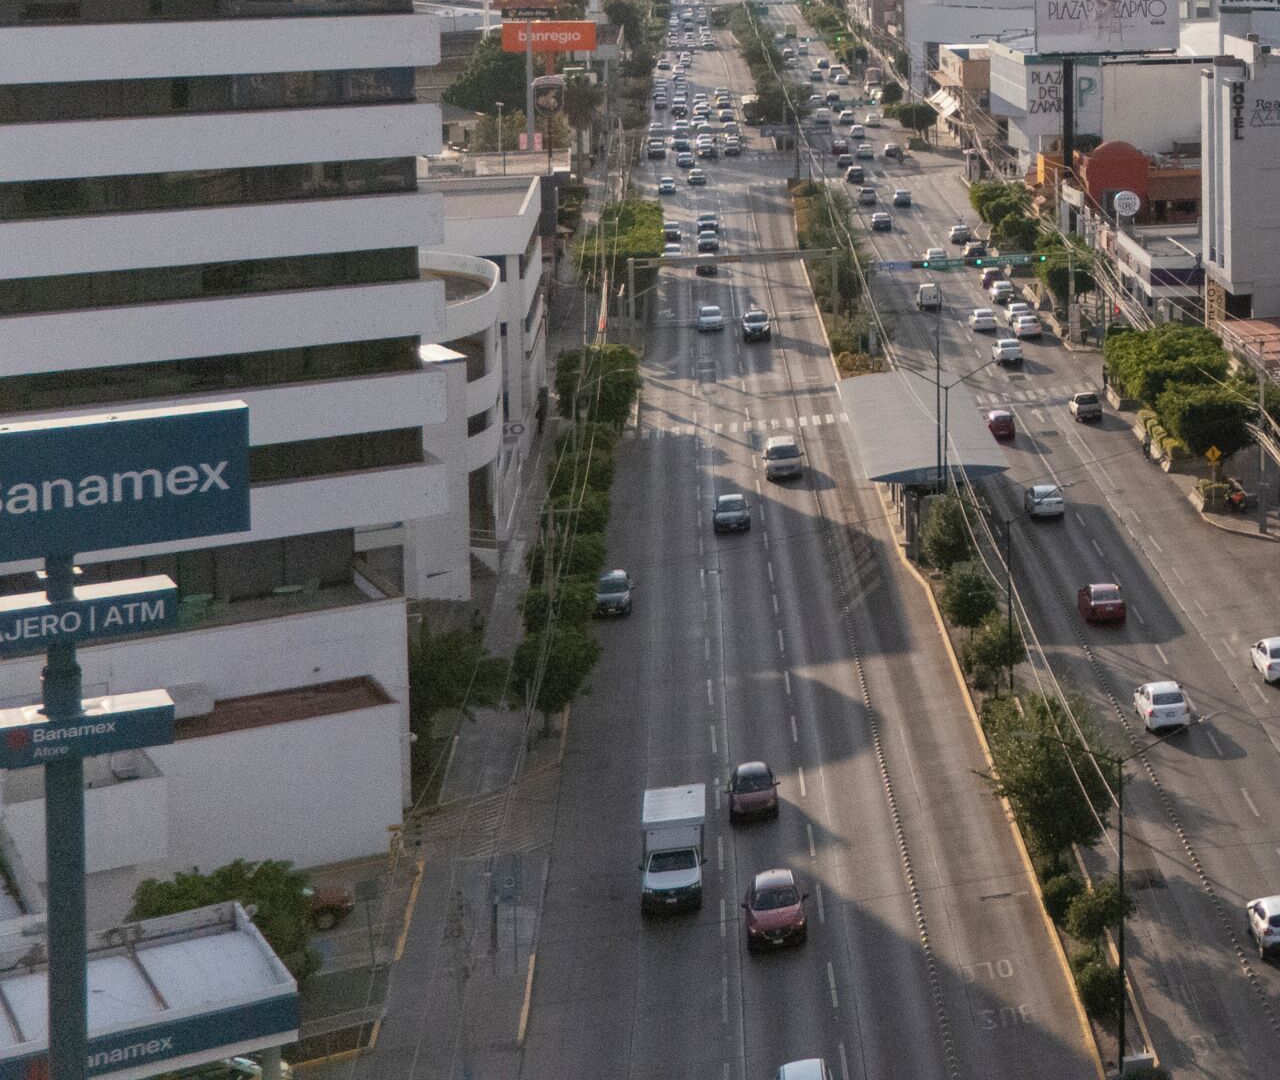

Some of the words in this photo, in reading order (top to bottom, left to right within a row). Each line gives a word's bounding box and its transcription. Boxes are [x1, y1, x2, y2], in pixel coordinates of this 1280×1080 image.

[1048, 1, 1089, 20] PLAZA
[1233, 81, 1245, 140] HOTEL
[0, 460, 230, 515] anamex
[0, 610, 81, 642] JERO
[104, 599, 165, 628] ATM
[33, 721, 116, 742] Banamex
[34, 743, 69, 758] Afore
[87, 1035, 173, 1068] namex
